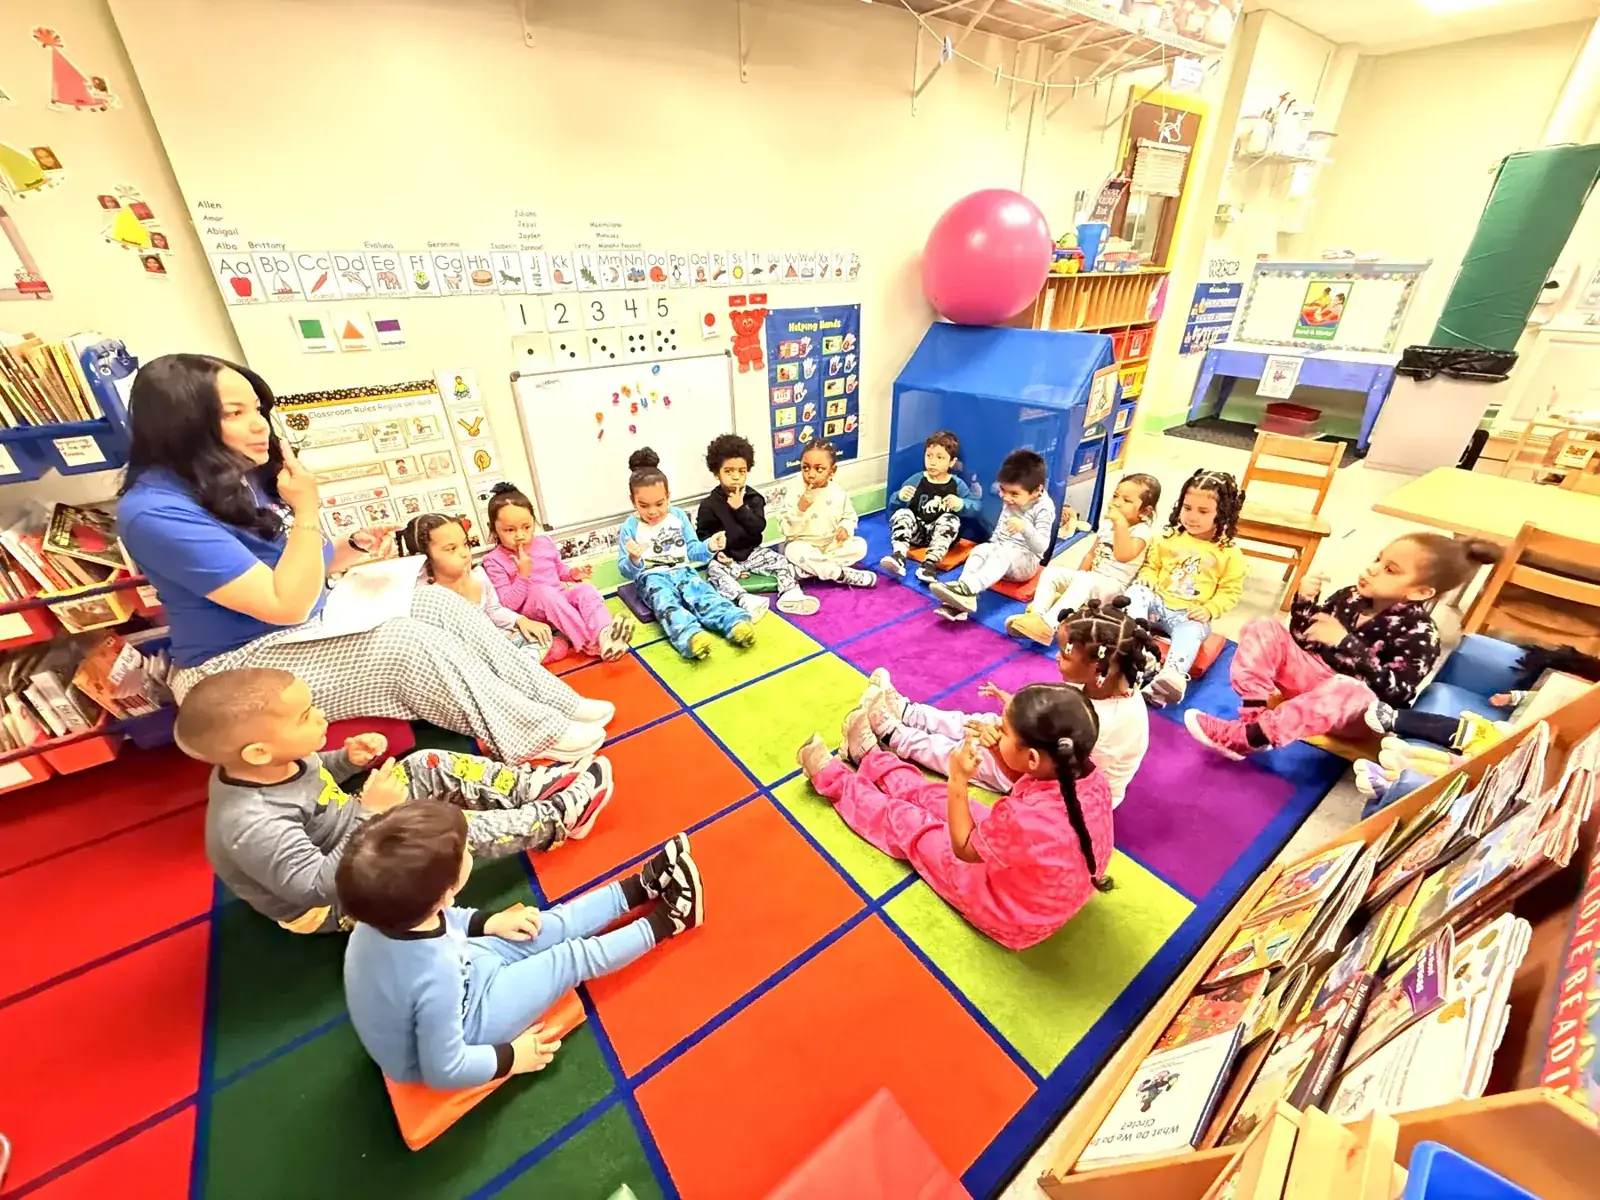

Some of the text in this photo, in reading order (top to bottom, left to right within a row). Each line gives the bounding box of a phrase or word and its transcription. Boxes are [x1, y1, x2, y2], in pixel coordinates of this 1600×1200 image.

[197, 200, 222, 209] Allen
[206, 227, 239, 238] Abigail
[248, 241, 286, 252] Brittany
[364, 241, 394, 249] Evaluna
[260, 256, 289, 272] Bb
[298, 254, 330, 271] Cc
[334, 255, 365, 271] Dd
[371, 255, 395, 271] Ee
[409, 255, 424, 270] Ff
[435, 255, 463, 273] Gg
[467, 255, 490, 269] Hh
[531, 255, 541, 273] Jj
[551, 254, 569, 268] Kk
[598, 254, 620, 266] Mm
[624, 253, 643, 266] Nn
[647, 254, 665, 266] Oo
[669, 254, 686, 267] Pp
[713, 253, 726, 267] Rr
[732, 253, 743, 264] Ss
[767, 252, 780, 264] Uu
[220, 258, 252, 277] Aa
[519, 303, 528, 326] 1
[554, 302, 570, 325] 2
[591, 300, 606, 322] 3
[624, 298, 638, 319] 4
[657, 297, 669, 318] 5
[788, 318, 842, 333] Helping Hands
[612, 392, 620, 404] 2
[308, 409, 352, 420] Classroom
[353, 404, 377, 413] Rules
[630, 402, 638, 414] 5
[353, 491, 371, 501] Kind
[1570, 885, 1600, 964] LOVE
[1120, 1118, 1156, 1131] Circle?
[1152, 1124, 1179, 1138] What
[1102, 1136, 1113, 1144] Do
[1116, 1133, 1134, 1142] We
[1136, 1131, 1148, 1139] Do
